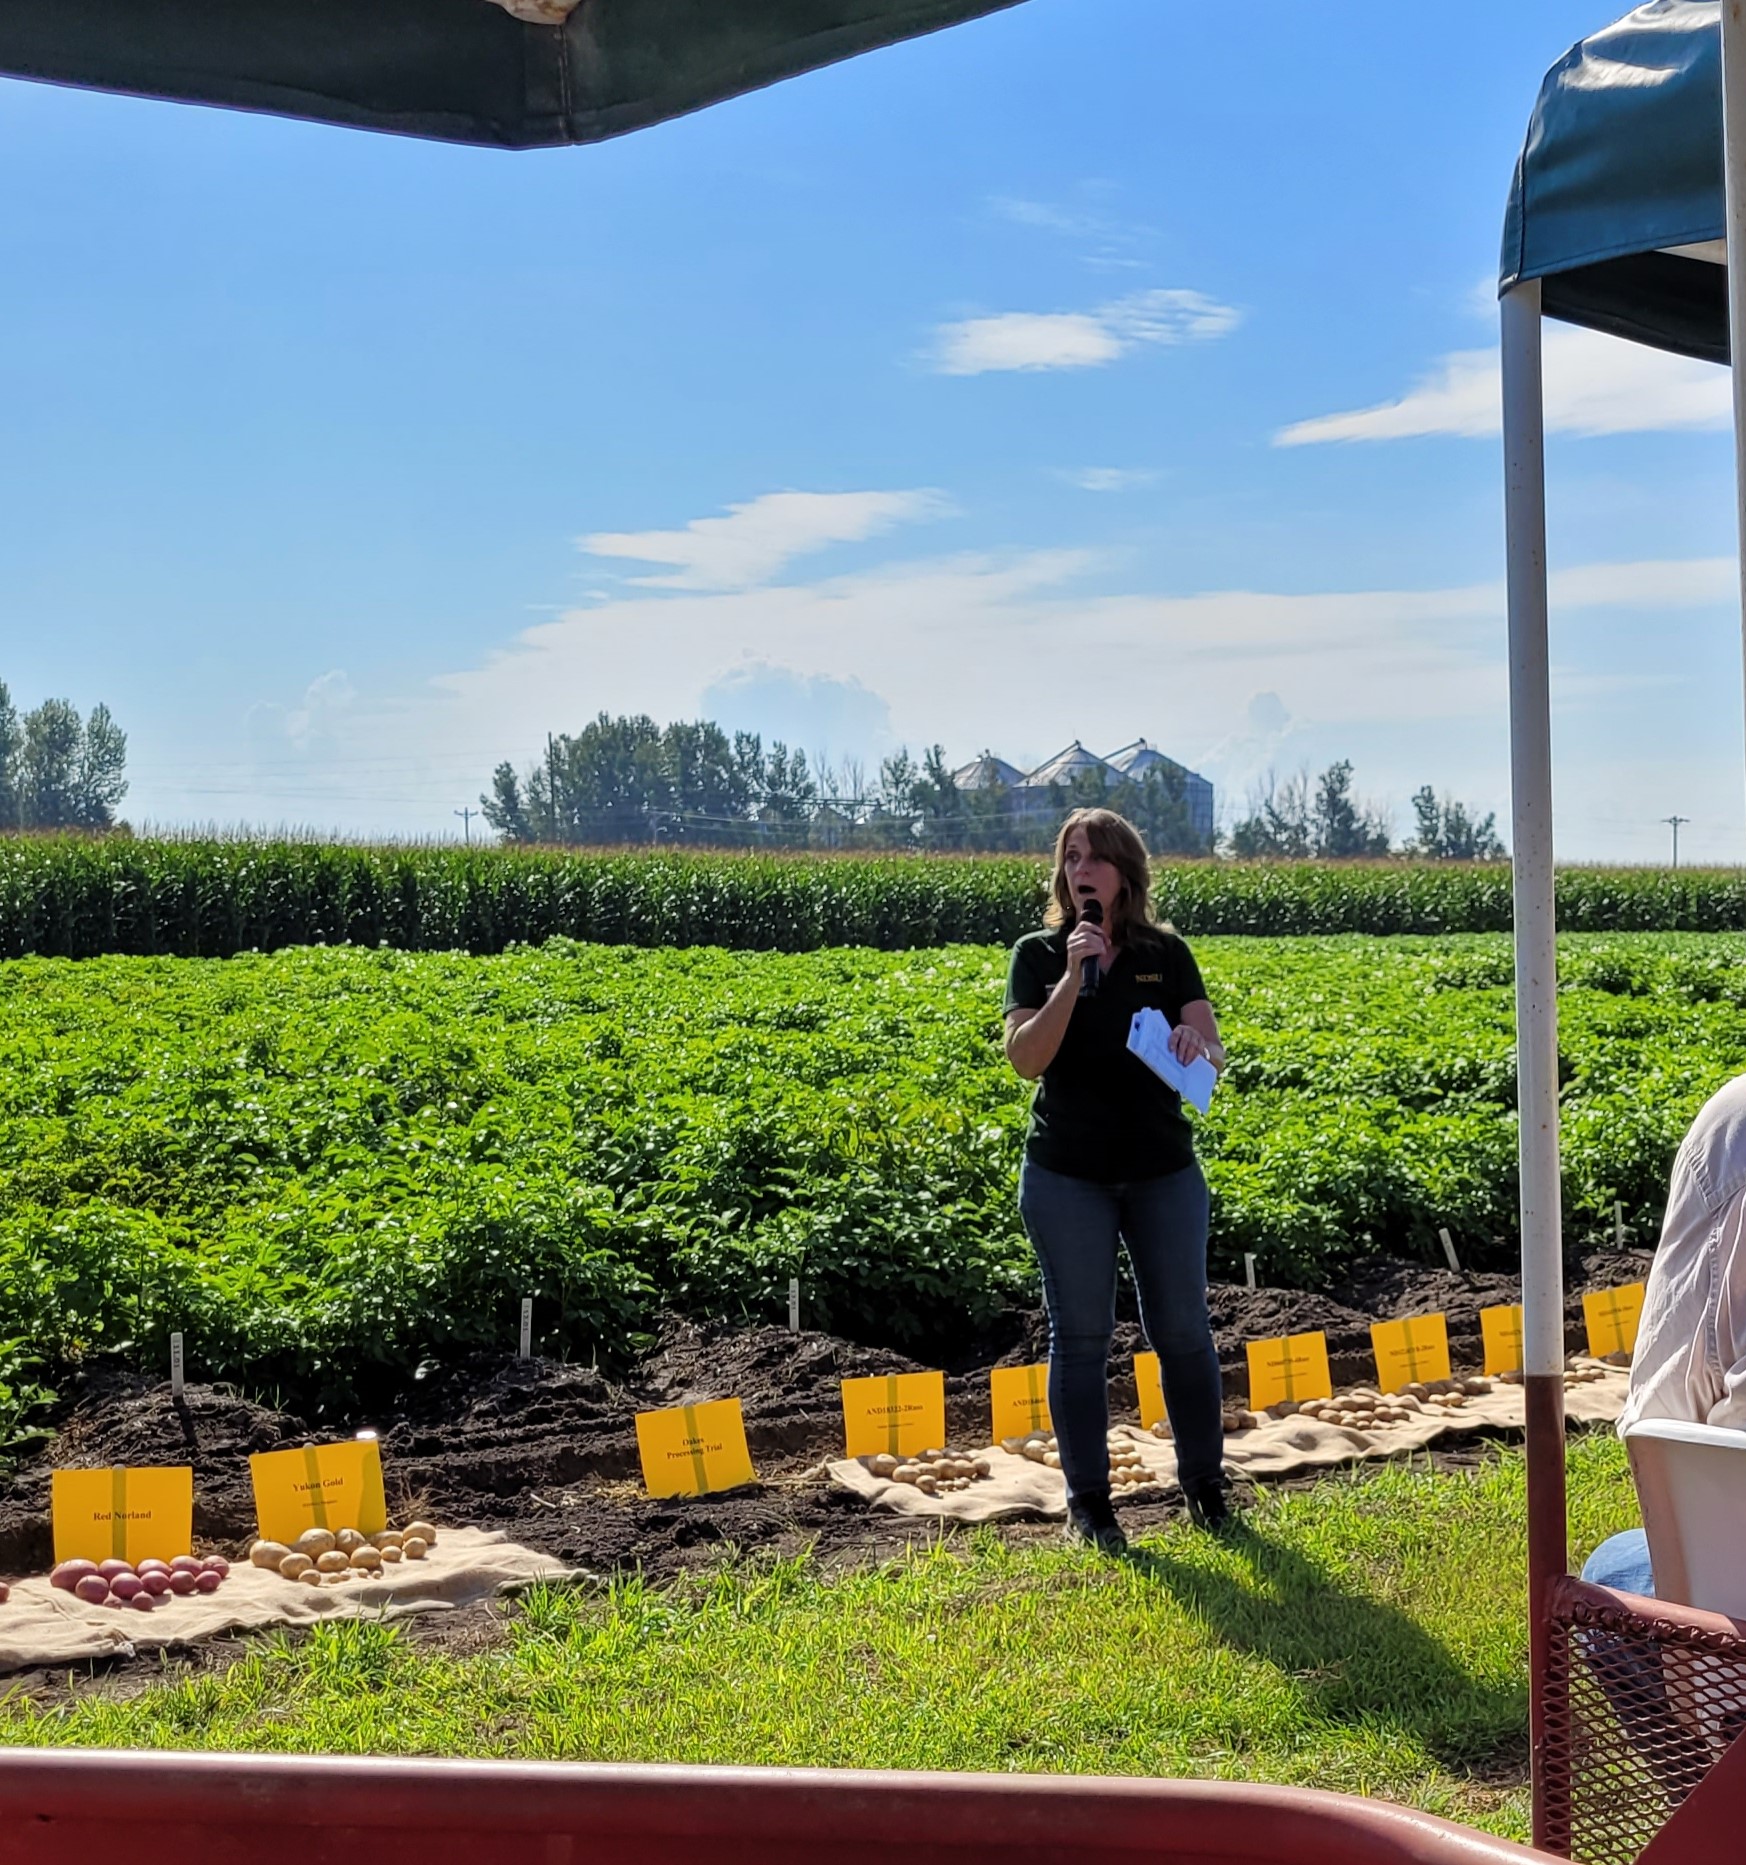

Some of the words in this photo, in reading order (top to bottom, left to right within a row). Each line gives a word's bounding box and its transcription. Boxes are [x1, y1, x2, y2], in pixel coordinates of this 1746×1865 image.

[667, 1448, 704, 1460] Processing
[705, 1443, 723, 1453] Trial
[293, 1482, 321, 1492] Yukon
[323, 1477, 343, 1488] Gold
[93, 1512, 112, 1521] Red
[114, 1511, 152, 1520] Norland
